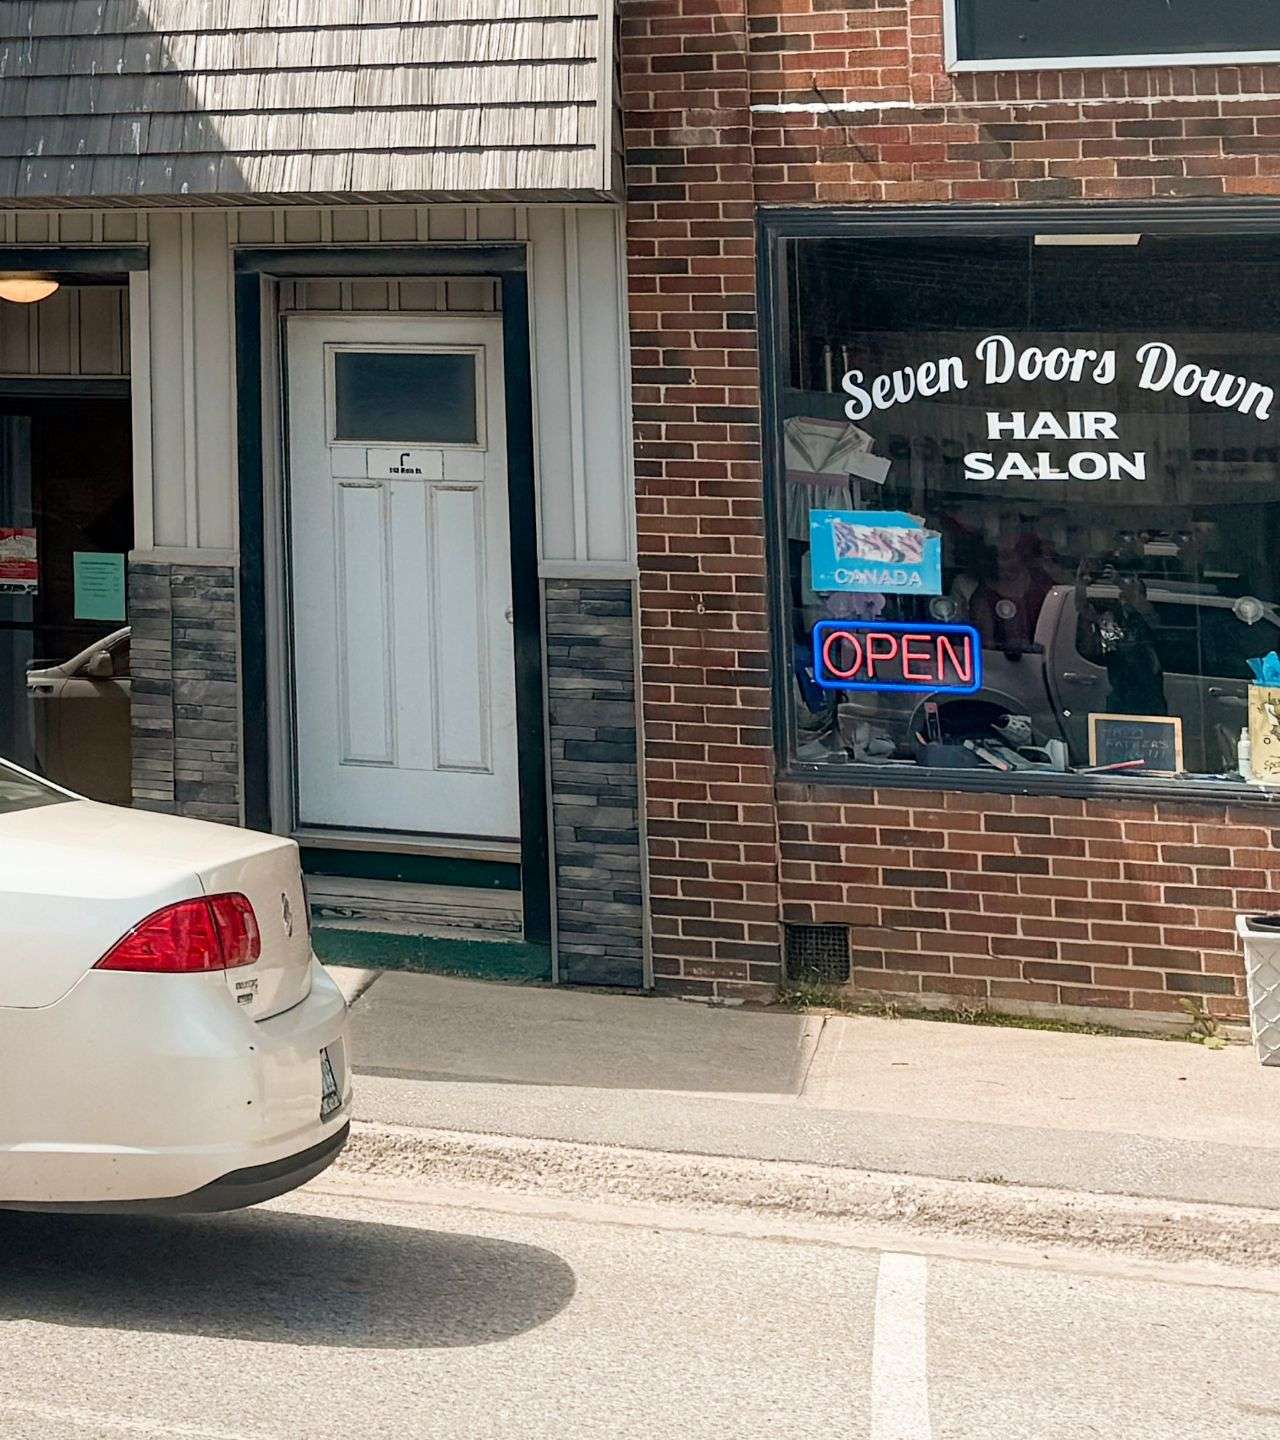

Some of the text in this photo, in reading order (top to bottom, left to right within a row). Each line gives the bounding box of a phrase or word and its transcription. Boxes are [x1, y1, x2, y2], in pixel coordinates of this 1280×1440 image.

[841, 334, 1275, 421] Seven Doors Down
[985, 411, 1119, 440] HAIR
[963, 452, 1146, 481] SALON
[834, 568, 922, 587] CANADA
[823, 630, 973, 682] OPEN
